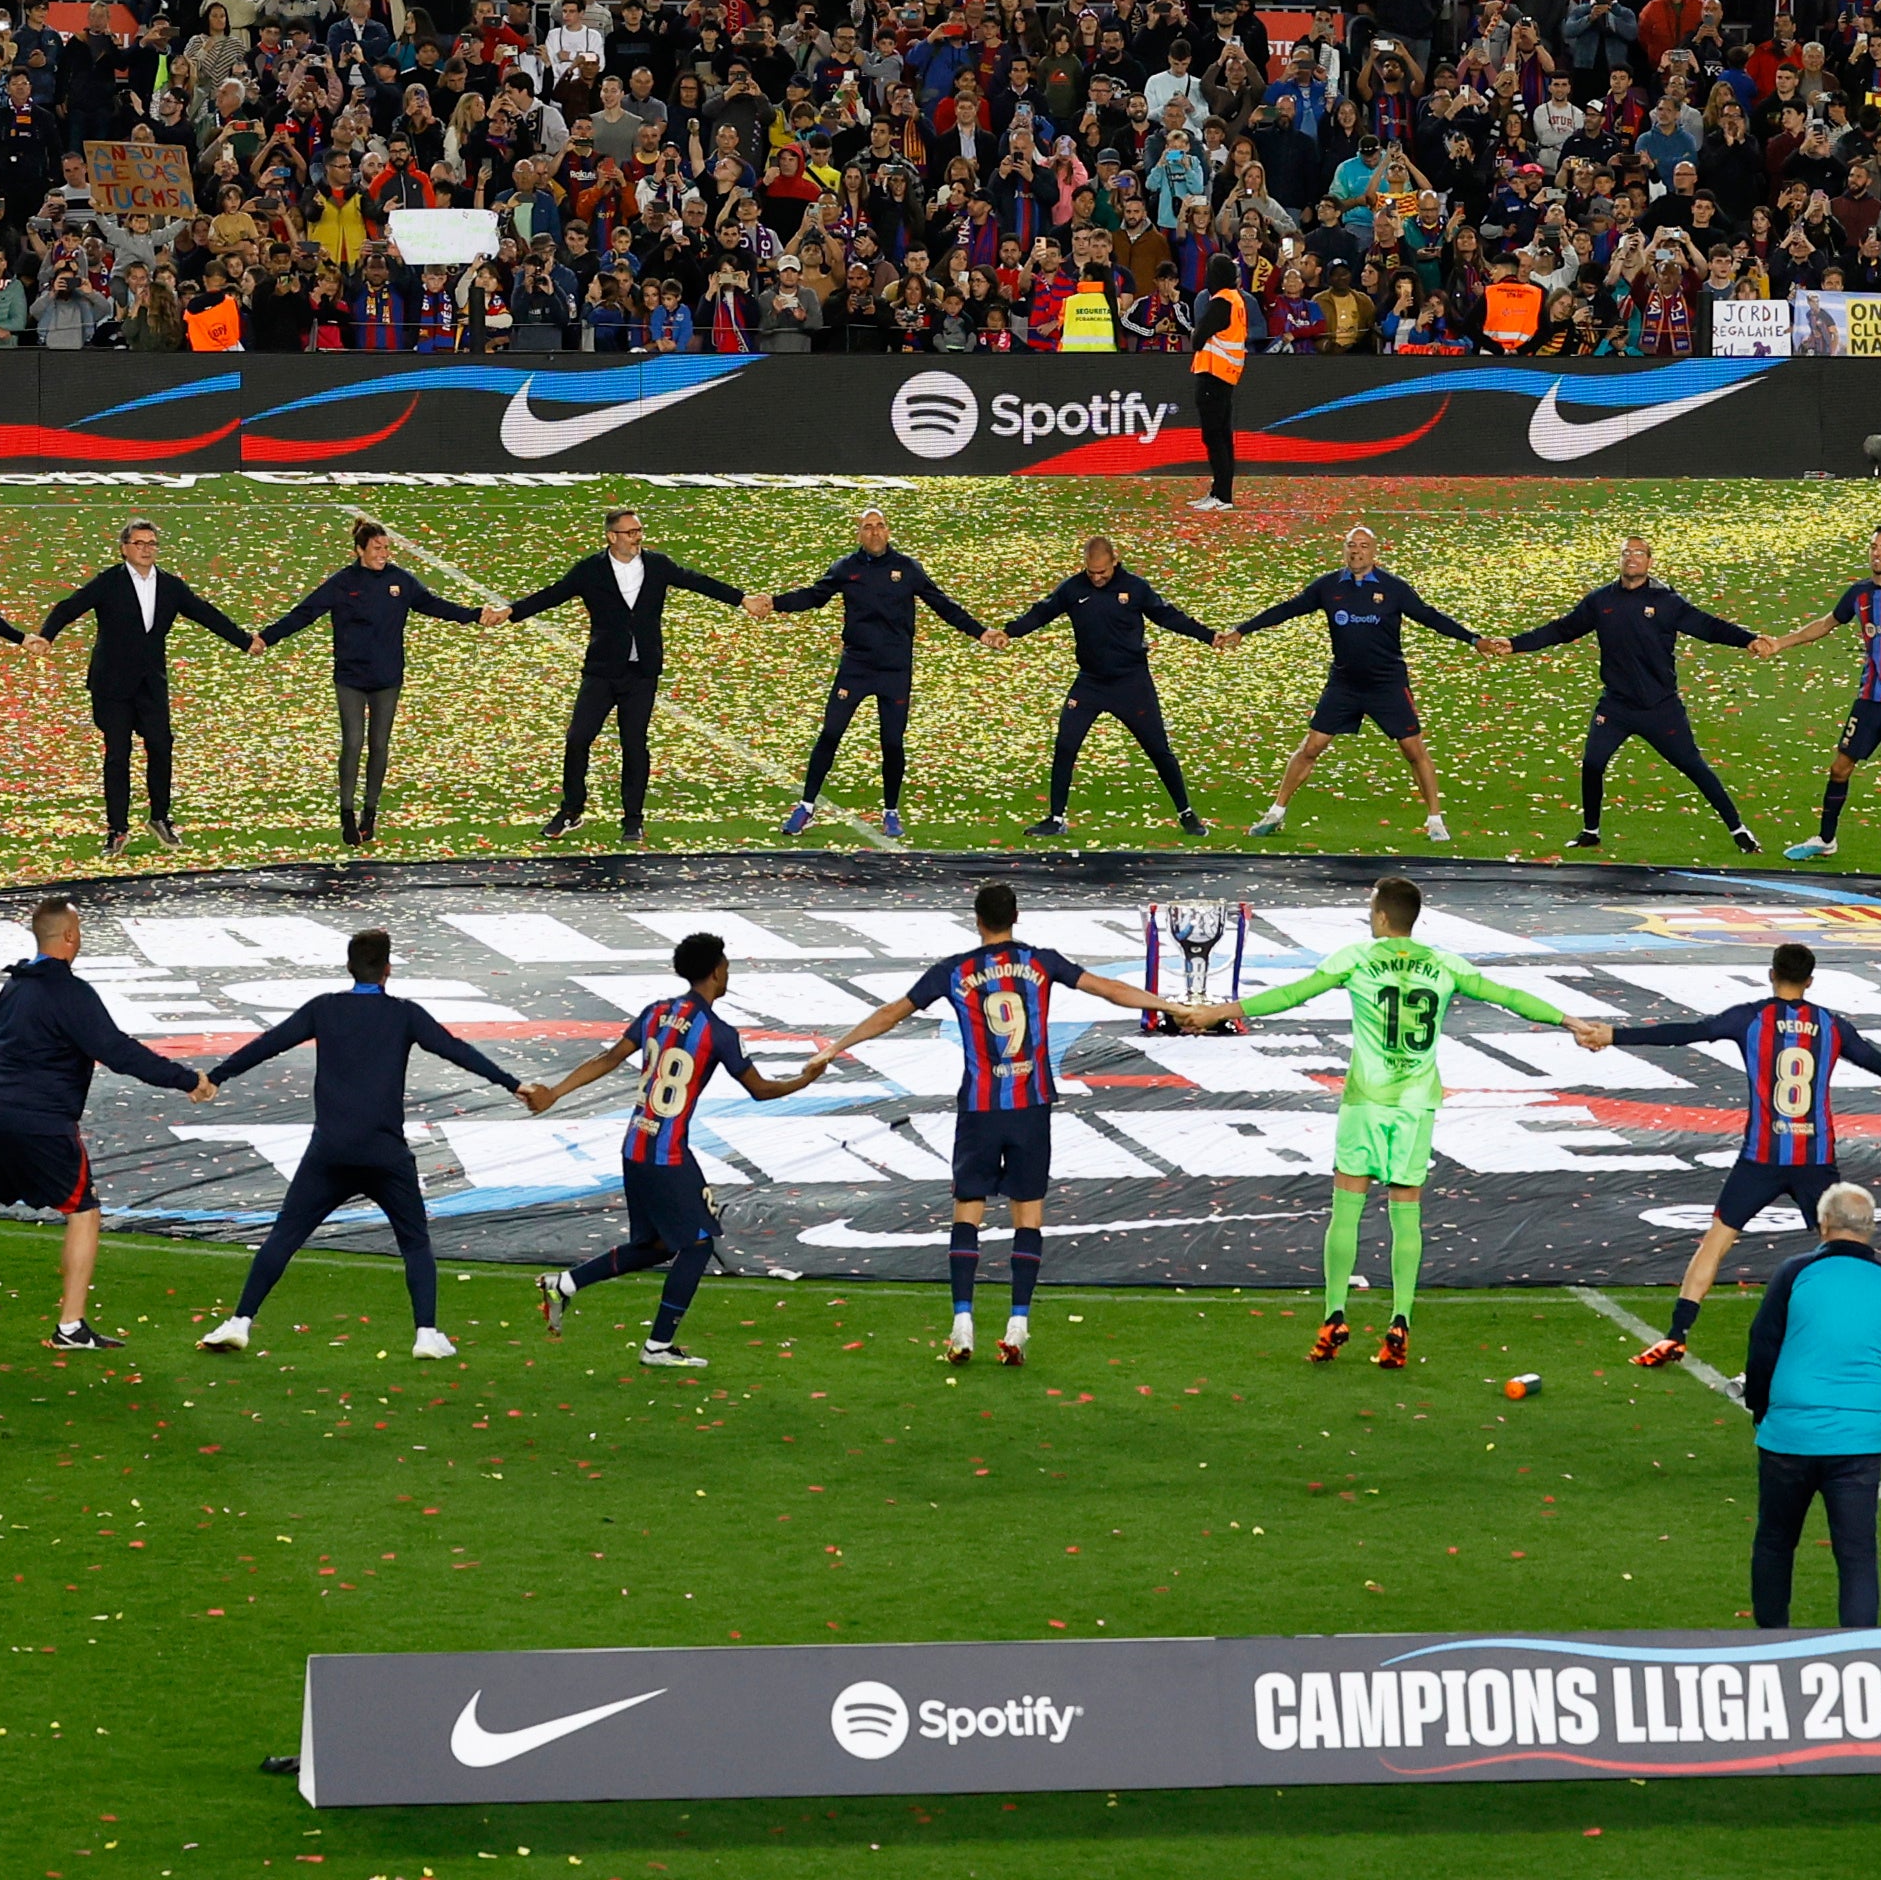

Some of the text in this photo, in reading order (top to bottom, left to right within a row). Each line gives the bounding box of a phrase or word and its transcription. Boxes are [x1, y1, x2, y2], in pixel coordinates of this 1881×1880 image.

[93, 163, 182, 183] ME DAS
[989, 389, 1169, 445] Spotify
[1846, 716, 1859, 738] 5
[955, 962, 1048, 999] LEWANDOWSKI
[983, 990, 1027, 1058] 9
[1374, 986, 1440, 1054] 13
[1776, 1019, 1819, 1037] PEDRI
[640, 1037, 695, 1118] 28
[1773, 1046, 1816, 1117] 8
[917, 1694, 1074, 1746] Spotify
[1254, 1666, 1600, 1751] CAMPIONS
[1613, 1663, 1790, 1743] LLIGA
